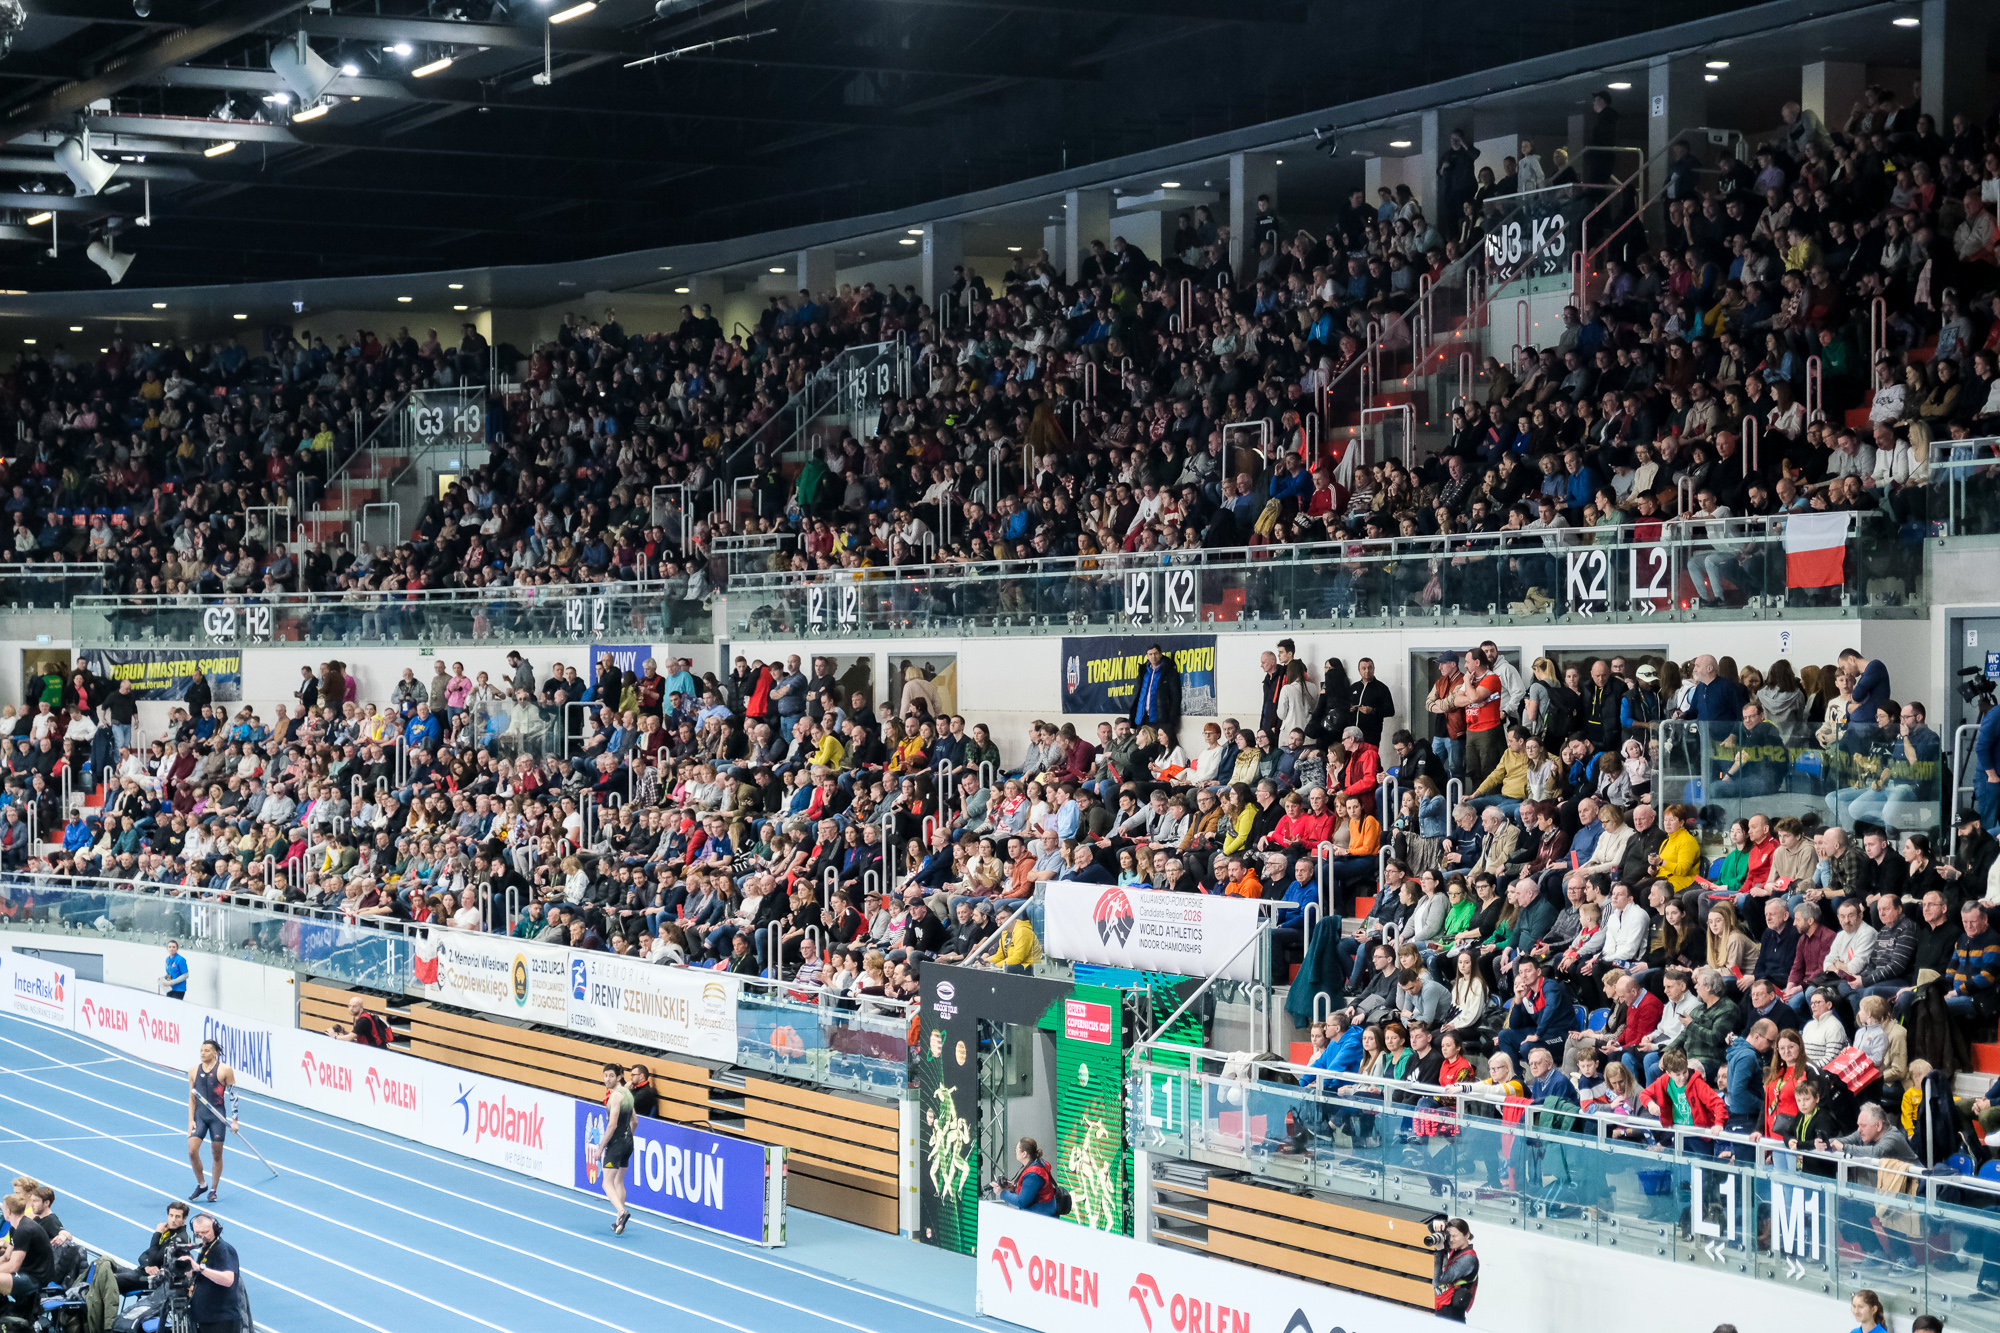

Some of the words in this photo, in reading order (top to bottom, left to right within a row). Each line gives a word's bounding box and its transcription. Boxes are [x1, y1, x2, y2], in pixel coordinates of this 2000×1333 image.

[1494, 222, 1521, 265] J3
[1532, 214, 1565, 257] K3
[416, 407, 443, 435] G3
[454, 405, 480, 432] H3
[1567, 550, 1606, 600] K2
[1630, 547, 1667, 598] L2
[810, 587, 822, 623] I2
[838, 586, 856, 623] J2
[1125, 572, 1149, 615] J2
[1165, 570, 1193, 612] K2
[204, 607, 234, 635] G2
[246, 607, 269, 635] H2
[566, 599, 582, 630] H2
[594, 598, 604, 629] I2
[147, 660, 197, 679] MIASTEM
[197, 657, 239, 675] SPORTU
[1087, 651, 1123, 683] TORUŃ
[1174, 647, 1214, 673] SPORTU
[1988, 655, 1999, 664] WC
[1139, 906, 1164, 918] Candidate
[1166, 908, 1183, 922] Region
[1183, 909, 1202, 922] 2026
[1140, 894, 1203, 908] KUJAWSKO-POMORSKIE
[191, 905, 206, 937] H1
[1139, 923, 1164, 936] WORLD
[1165, 925, 1203, 941] ATHLETICS
[449, 949, 454, 963] 2.
[1139, 938, 1160, 949] INDOOR
[532, 959, 548, 973] 22-23
[548, 960, 566, 975] LIPCA
[591, 962, 596, 975] 5.
[15, 972, 53, 999] InterRisk
[447, 967, 508, 1002] Czapiewskiego
[532, 993, 566, 1012] BYDGOSZCZ
[624, 988, 690, 1029] SZEWIŃSKIEJ
[1068, 1005, 1084, 1014] ORLEN
[98, 1006, 128, 1032] ORLEN
[151, 1018, 180, 1044] ORLEN
[575, 1014, 596, 1028] CZERWCA
[1067, 1017, 1099, 1031] COPERNICUS
[1099, 1023, 1110, 1033] CUP
[616, 1023, 637, 1037] STADION
[638, 1028, 659, 1041] ZAWISZY
[660, 1031, 689, 1048] BYDGOSZCZ
[204, 1015, 273, 1089] CISOWIANKA
[319, 1061, 351, 1093] ORLEN
[383, 1078, 416, 1111] ORLEN
[1145, 1072, 1172, 1130] L1
[476, 1094, 544, 1150] polanik
[633, 1136, 723, 1210] TORUŃ
[1694, 1168, 1736, 1241] L1
[1771, 1181, 1820, 1261] M1
[1028, 1254, 1098, 1308] ORLEN
[1170, 1293, 1250, 1333] ORLEN
